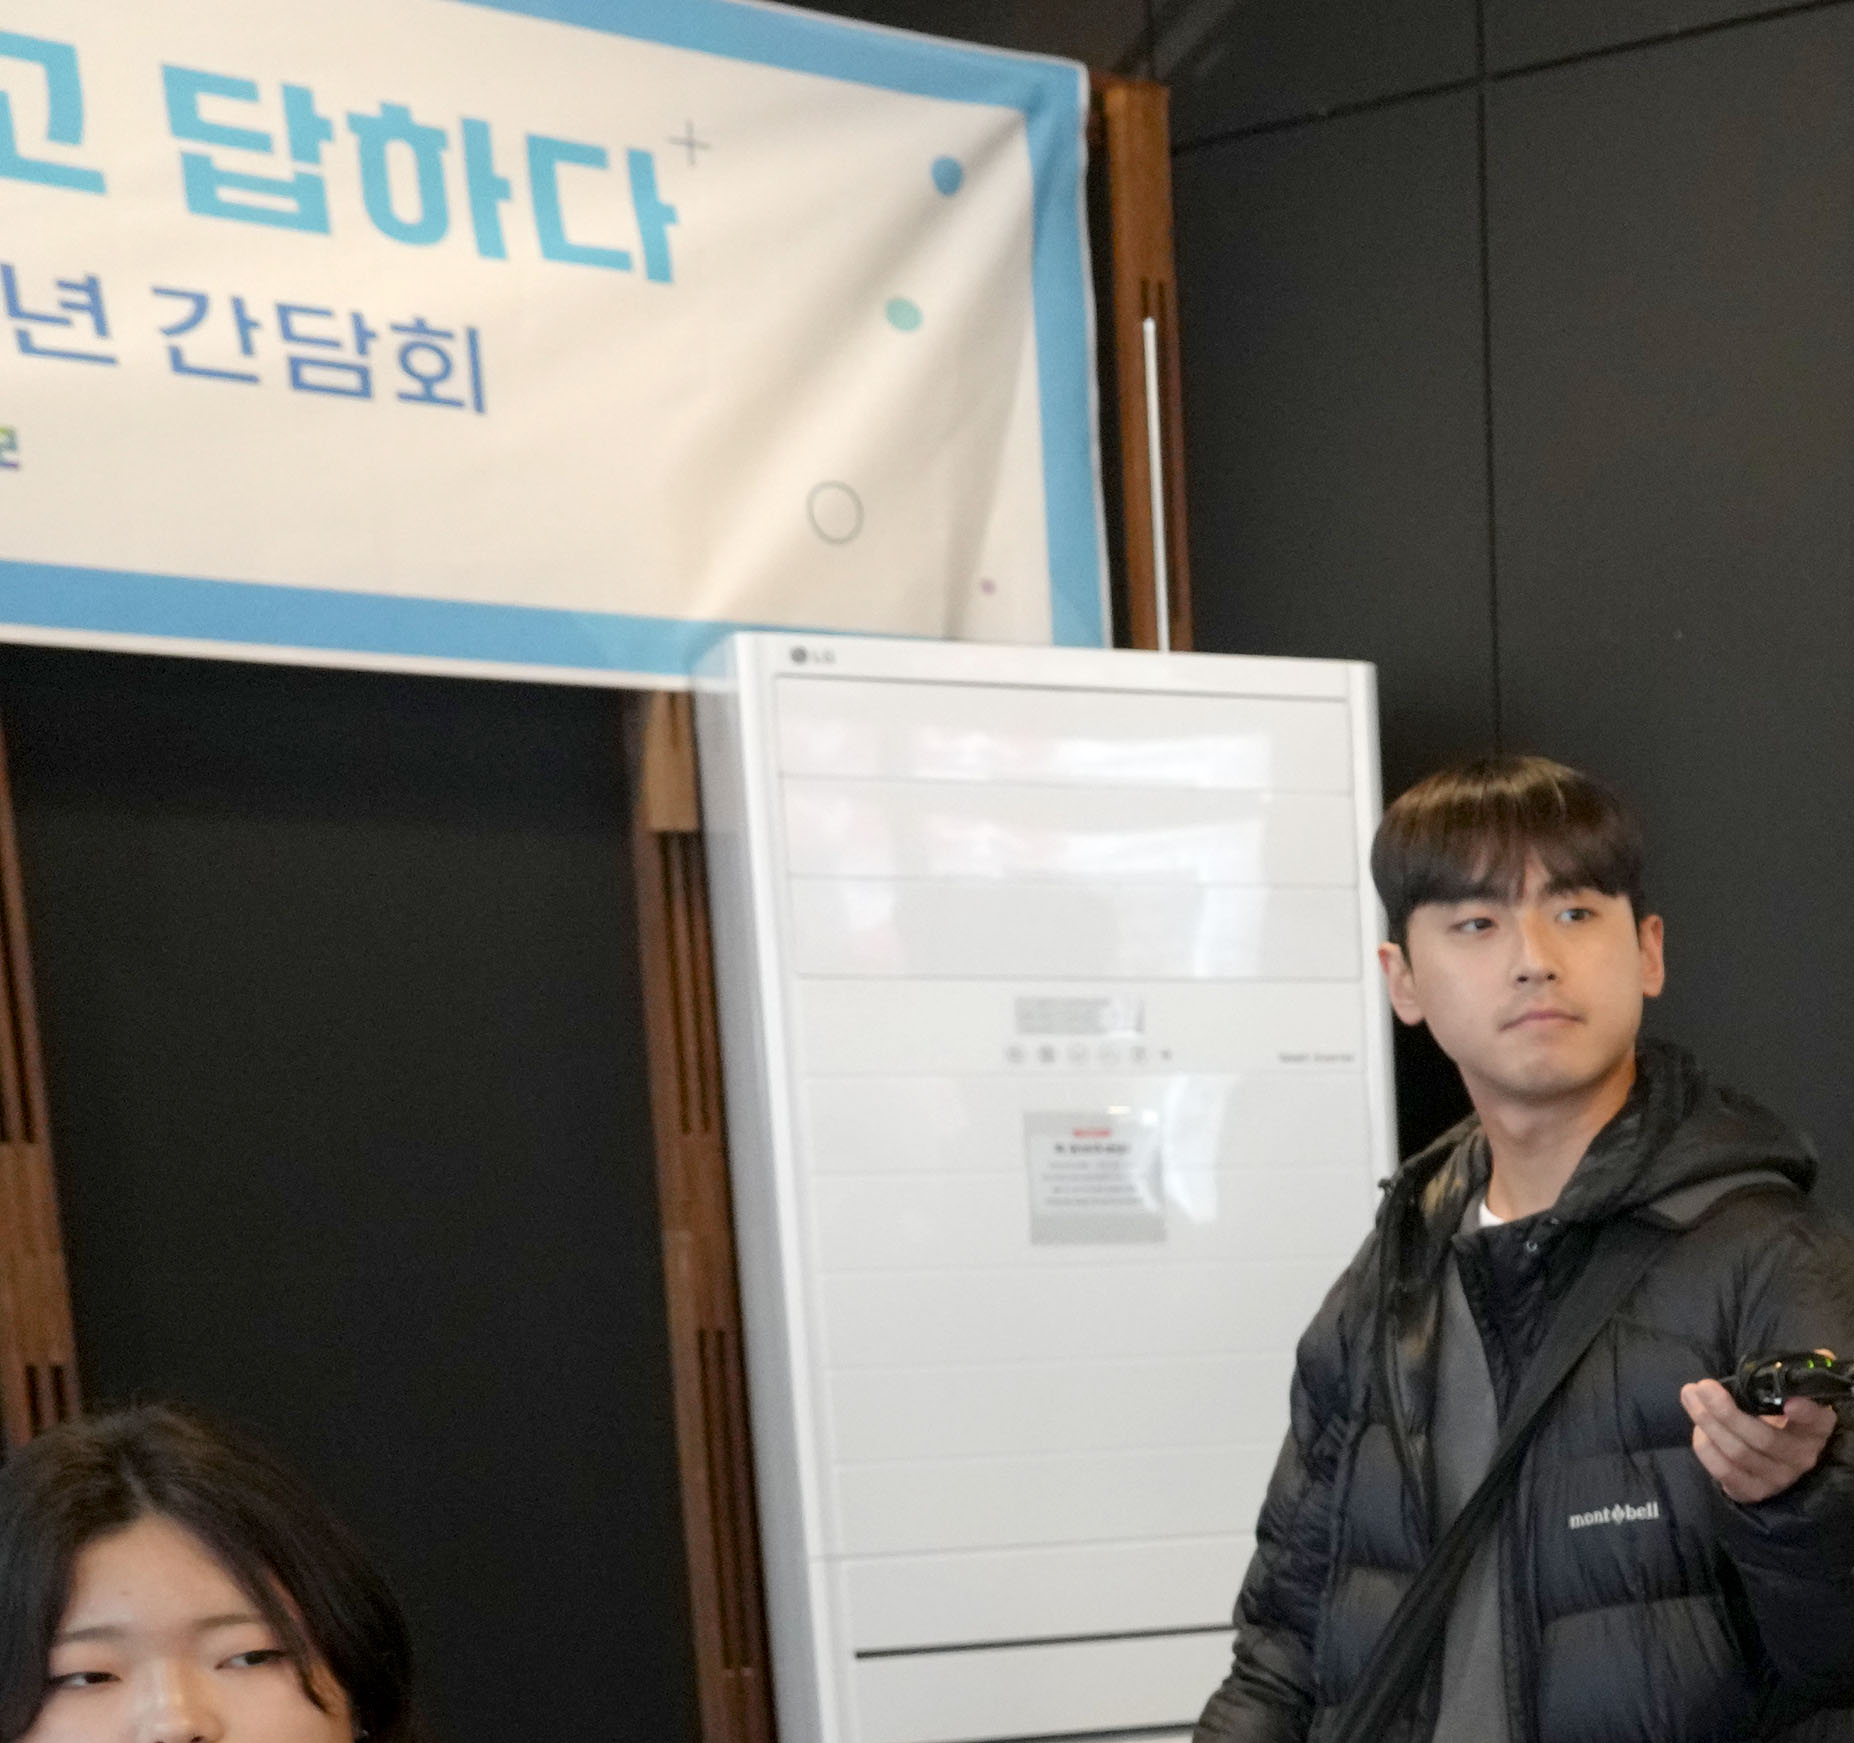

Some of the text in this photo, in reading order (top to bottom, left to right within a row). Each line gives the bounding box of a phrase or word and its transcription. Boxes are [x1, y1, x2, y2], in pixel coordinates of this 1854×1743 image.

[161, 62, 680, 284] 답하다
[0, 262, 486, 416] 년 간담회
